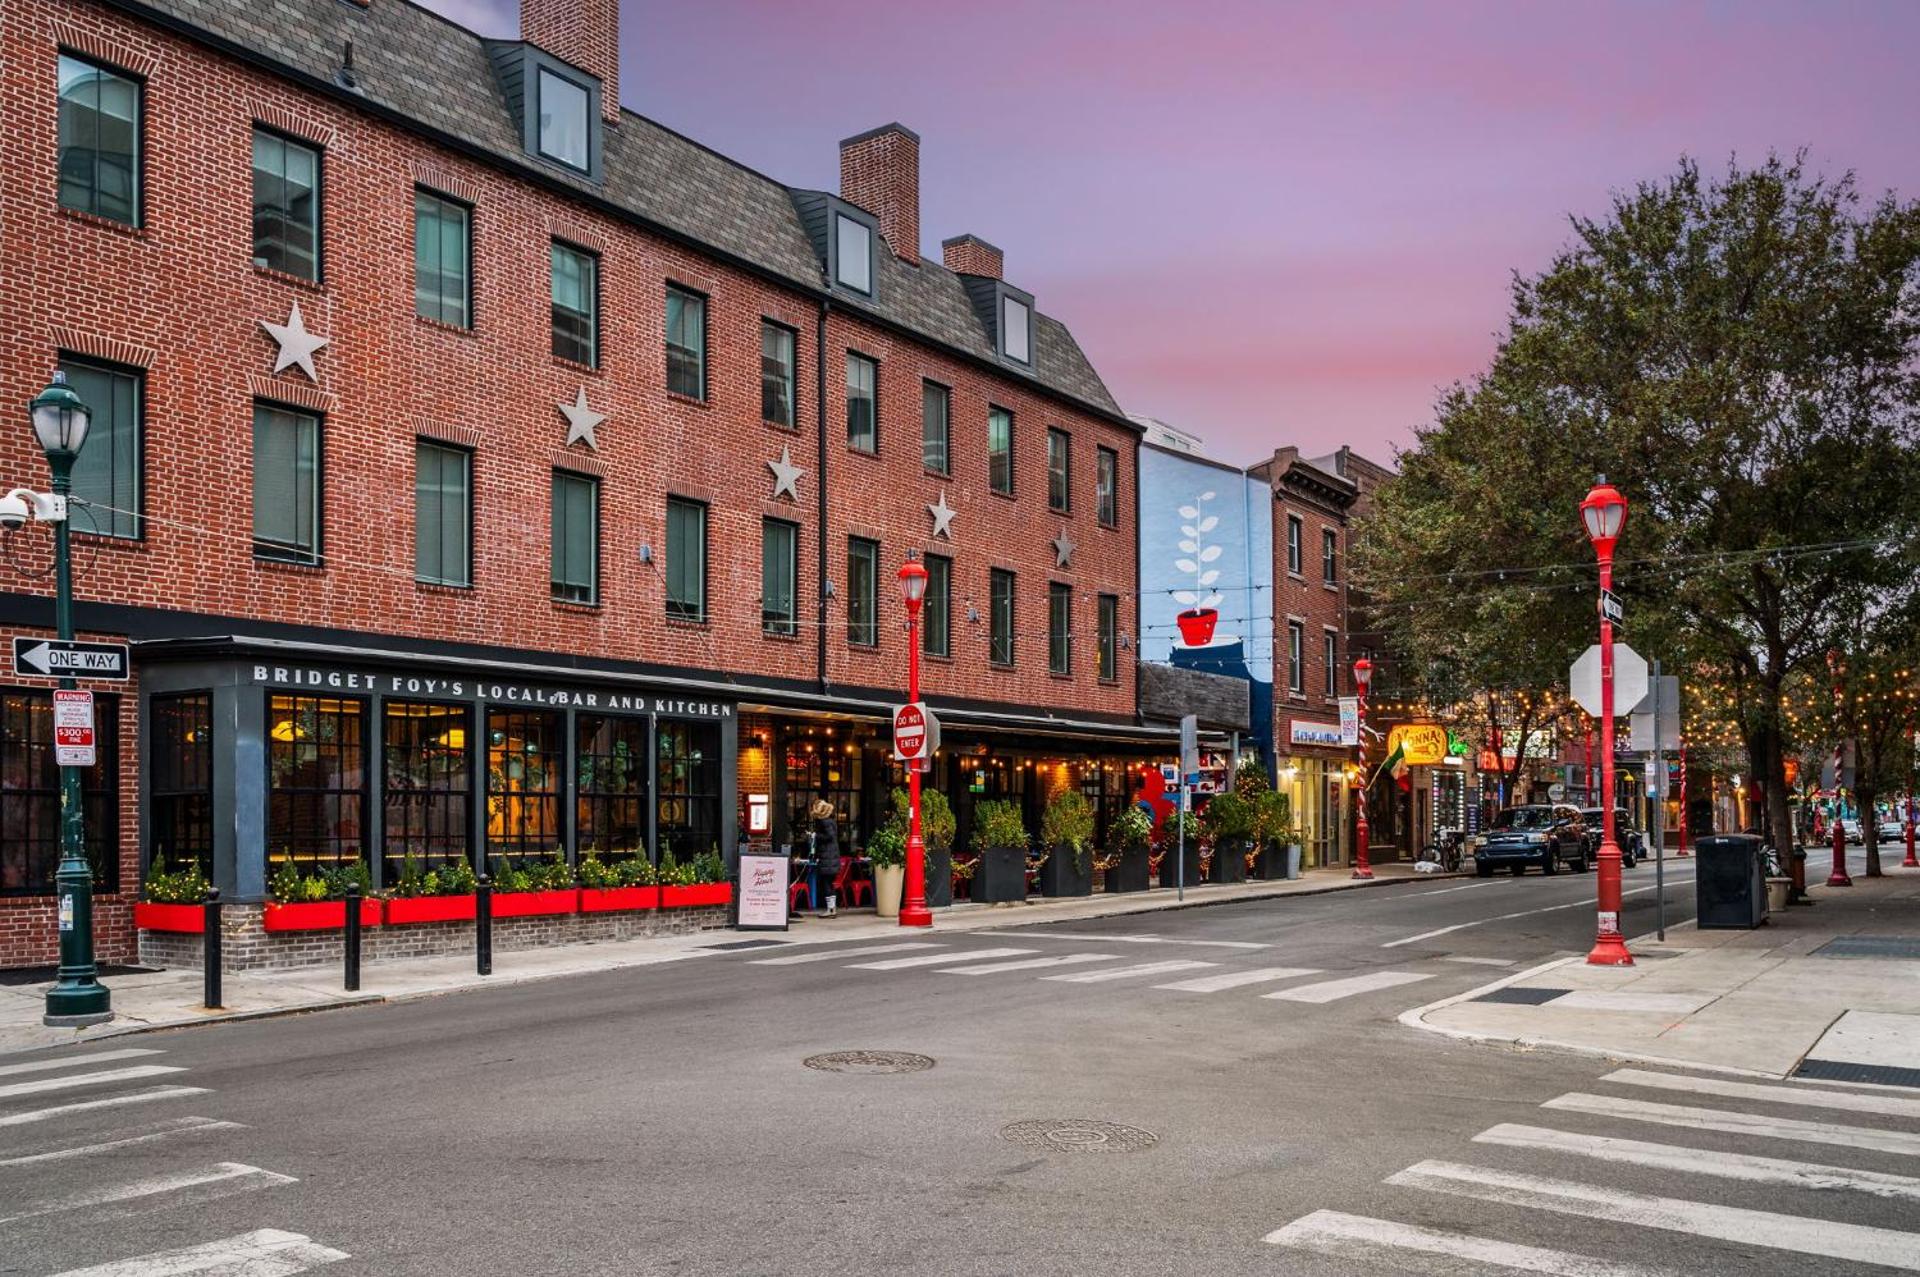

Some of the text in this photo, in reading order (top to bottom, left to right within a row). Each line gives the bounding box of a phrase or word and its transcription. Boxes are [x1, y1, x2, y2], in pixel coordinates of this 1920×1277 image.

[49, 652, 115, 668] ONE WAY
[253, 665, 731, 716] BRIDGET FOY'S LOCAL BAR AND KITCHEN
[56, 693, 91, 703] WARNING
[897, 714, 920, 726] DO NOT
[900, 738, 920, 749] ENTER
